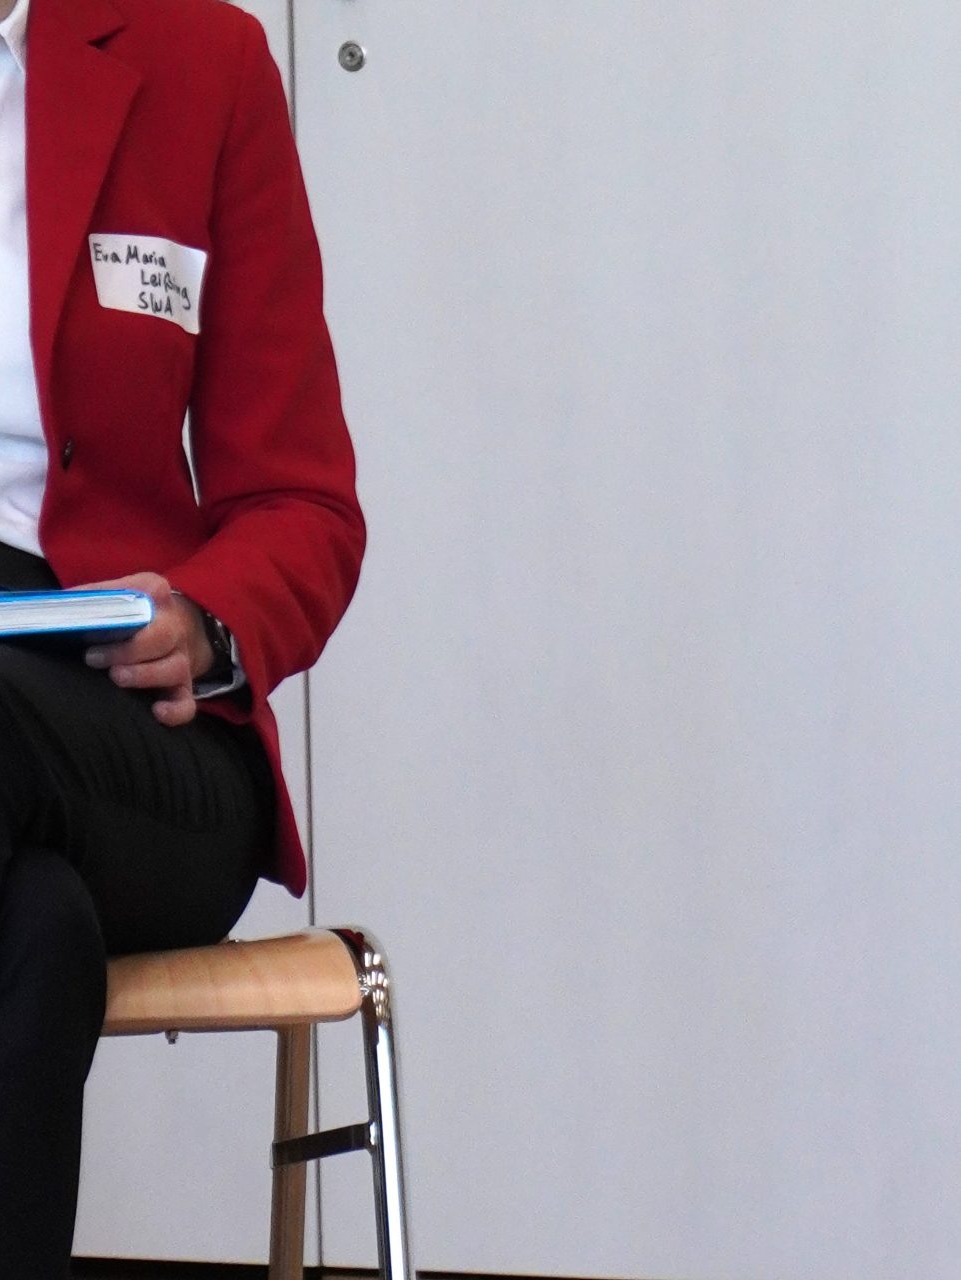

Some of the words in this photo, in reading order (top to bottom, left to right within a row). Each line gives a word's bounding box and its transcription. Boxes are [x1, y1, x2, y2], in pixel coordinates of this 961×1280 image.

[93, 242, 121, 263] Eva
[125, 244, 166, 268] Maria
[137, 291, 173, 316] SWA
